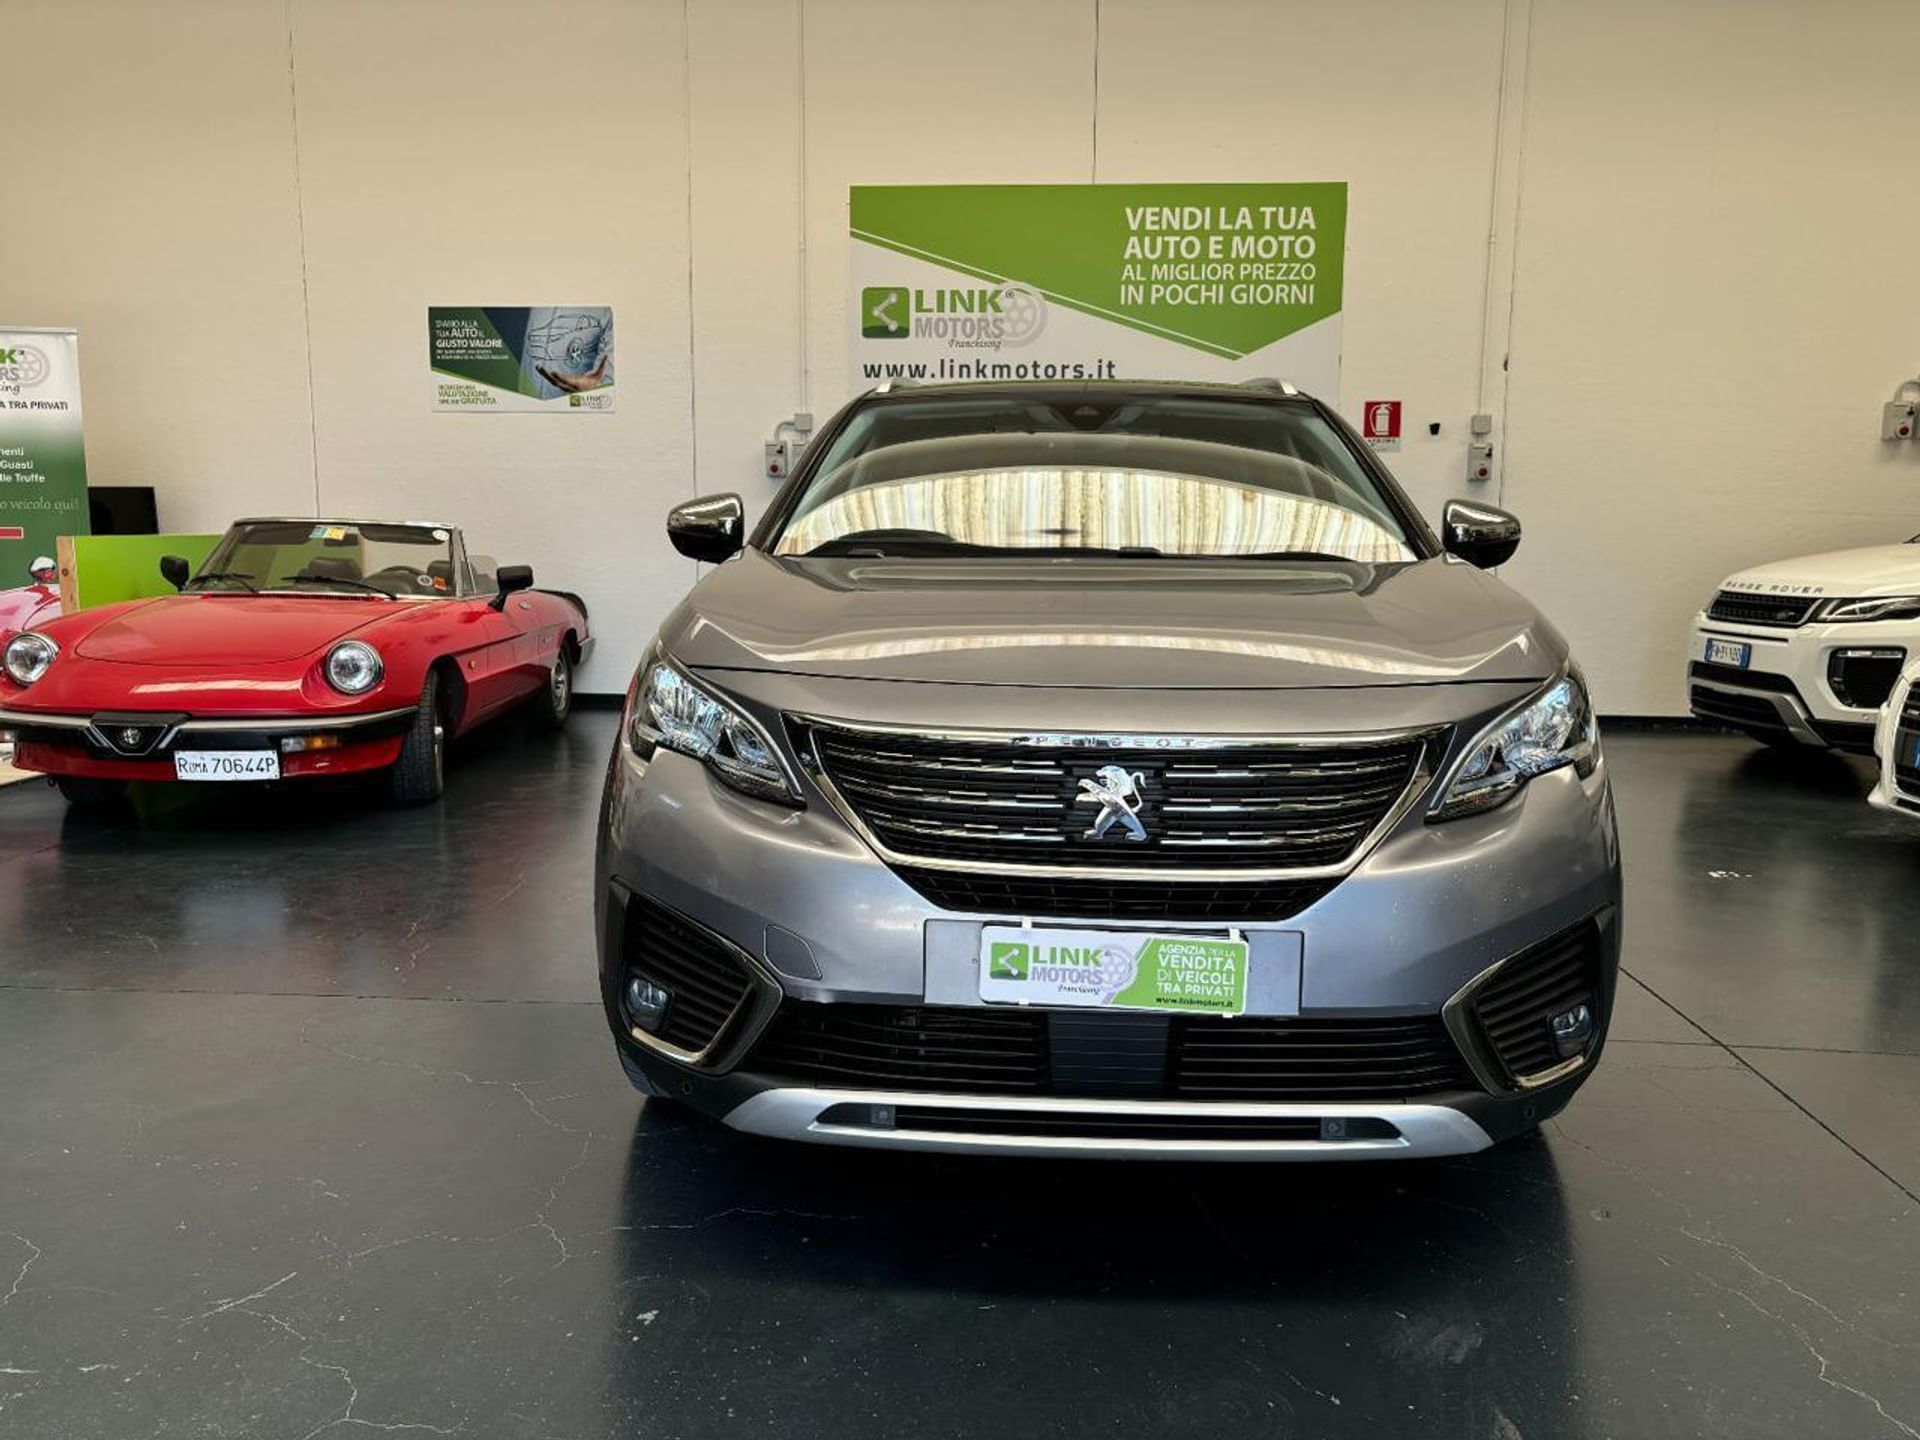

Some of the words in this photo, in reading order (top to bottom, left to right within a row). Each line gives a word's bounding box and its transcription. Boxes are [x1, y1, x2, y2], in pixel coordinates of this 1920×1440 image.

[1125, 206, 1211, 231] VENDI
[1218, 206, 1254, 231] LA
[1259, 206, 1317, 231] TUA
[1123, 235, 1201, 260] AUTO
[1208, 236, 1224, 259] E
[1230, 235, 1317, 260] MOTO
[1121, 263, 1147, 281] AL
[1151, 263, 1234, 281] MIGLIOR
[1240, 263, 1317, 281] PREZZO
[914, 289, 1004, 313] LINK
[1120, 284, 1144, 305] IN
[1150, 284, 1224, 305] POCHI
[1230, 284, 1315, 305] GIORNI
[451, 328, 478, 338] AUTO
[914, 317, 1005, 339] MOTORS
[435, 338, 468, 348] GIUSTO
[469, 338, 503, 349] VALORE
[948, 337, 1003, 350] Franchising
[863, 358, 1117, 379] www.linkmotors.it
[8, 401, 28, 409] TRA
[30, 401, 69, 411] PRIVATI
[14, 473, 46, 483] Truffe
[8, 496, 51, 510] veicolo
[1725, 580, 1763, 591] RANGE
[1768, 583, 1824, 594] ROVER
[1035, 735, 1196, 748] PEUGEOT
[211, 757, 276, 774] 70644P
[1032, 945, 1103, 968] LINK
[1157, 944, 1206, 957] AGENZIA
[1157, 953, 1236, 972] VENDITA
[1031, 966, 1104, 985] MOTORS
[1157, 968, 1172, 981] DI
[1175, 969, 1235, 986] VEICOLI
[1156, 981, 1181, 995] TRA
[1184, 983, 1235, 997] PRIVATI
[1155, 996, 1234, 1008] www.linkmotors.it
